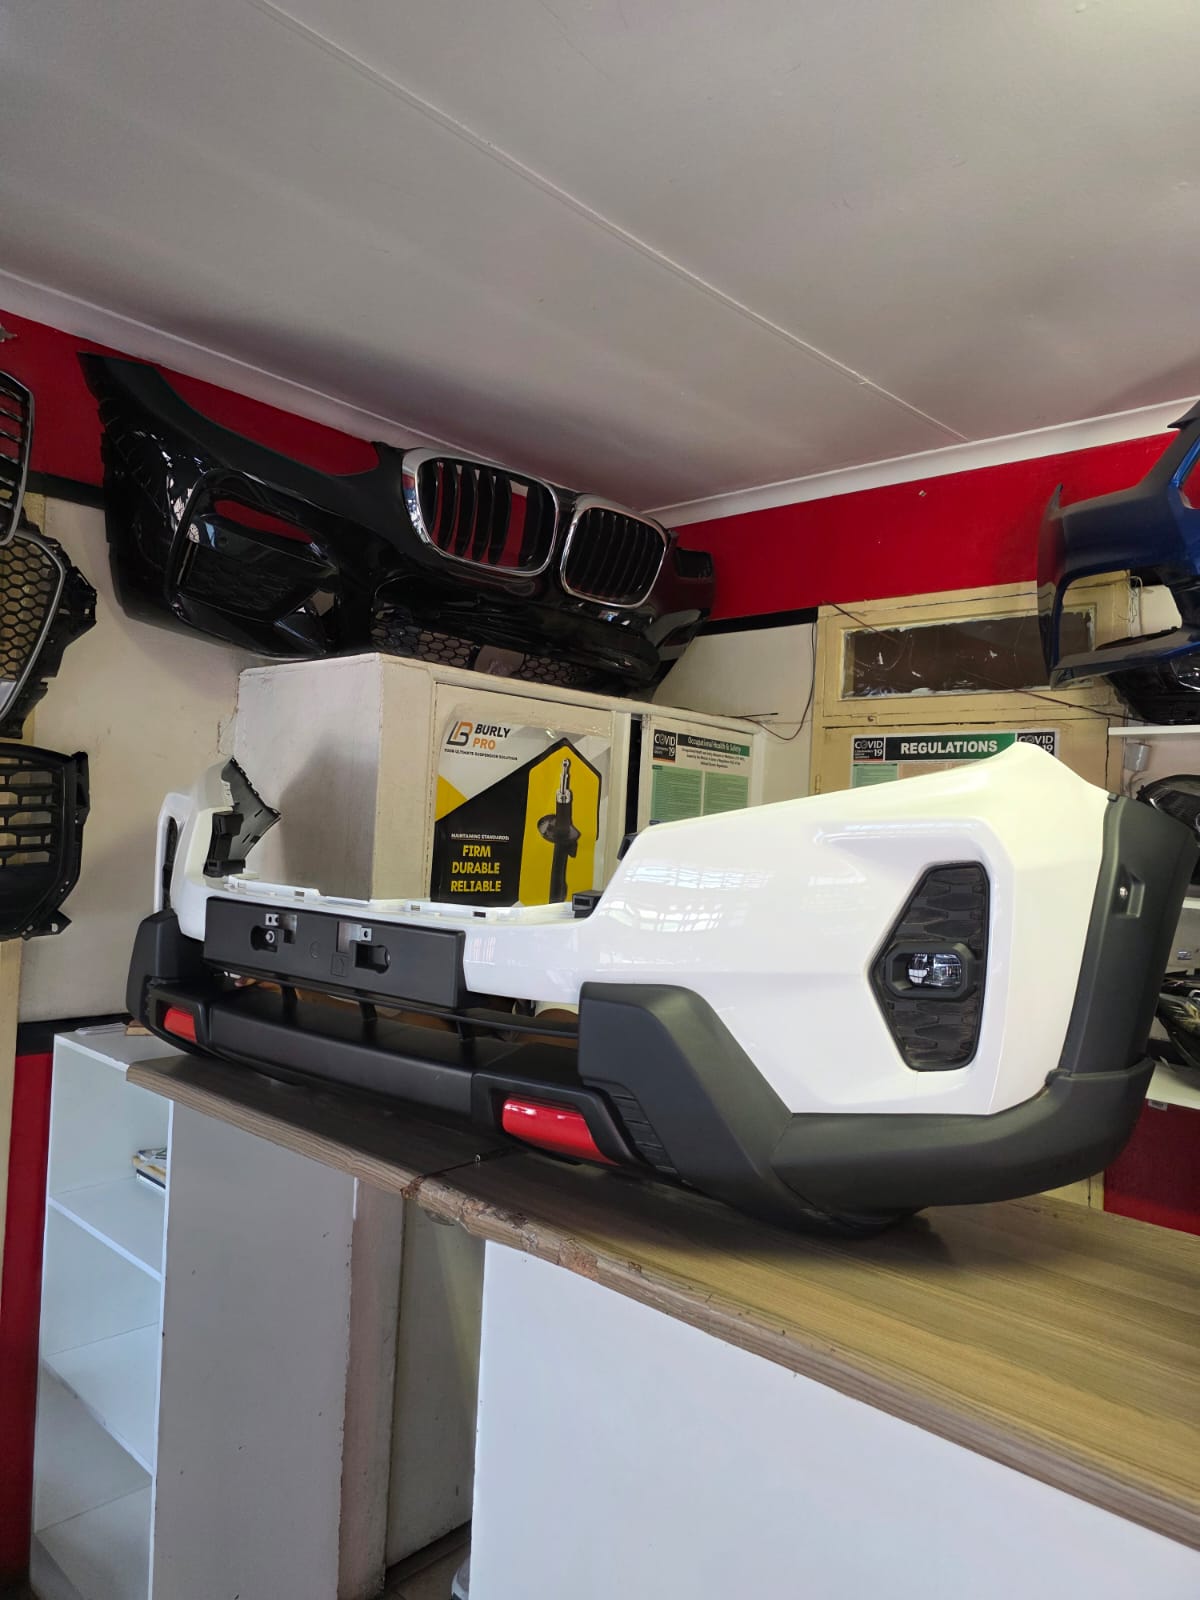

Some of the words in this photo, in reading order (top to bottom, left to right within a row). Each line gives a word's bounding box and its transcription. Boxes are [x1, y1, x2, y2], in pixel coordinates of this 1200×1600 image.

[475, 723, 511, 738] BURLY
[473, 737, 496, 750] PRO
[655, 734, 675, 746] COVID
[854, 740, 883, 749] COVID
[668, 746, 675, 757] 19
[874, 748, 883, 757] 19
[900, 740, 998, 754] REGULATIONS
[463, 845, 491, 857] FIRM
[451, 861, 500, 874] DURABLE
[450, 881, 501, 892] RELIABLE
